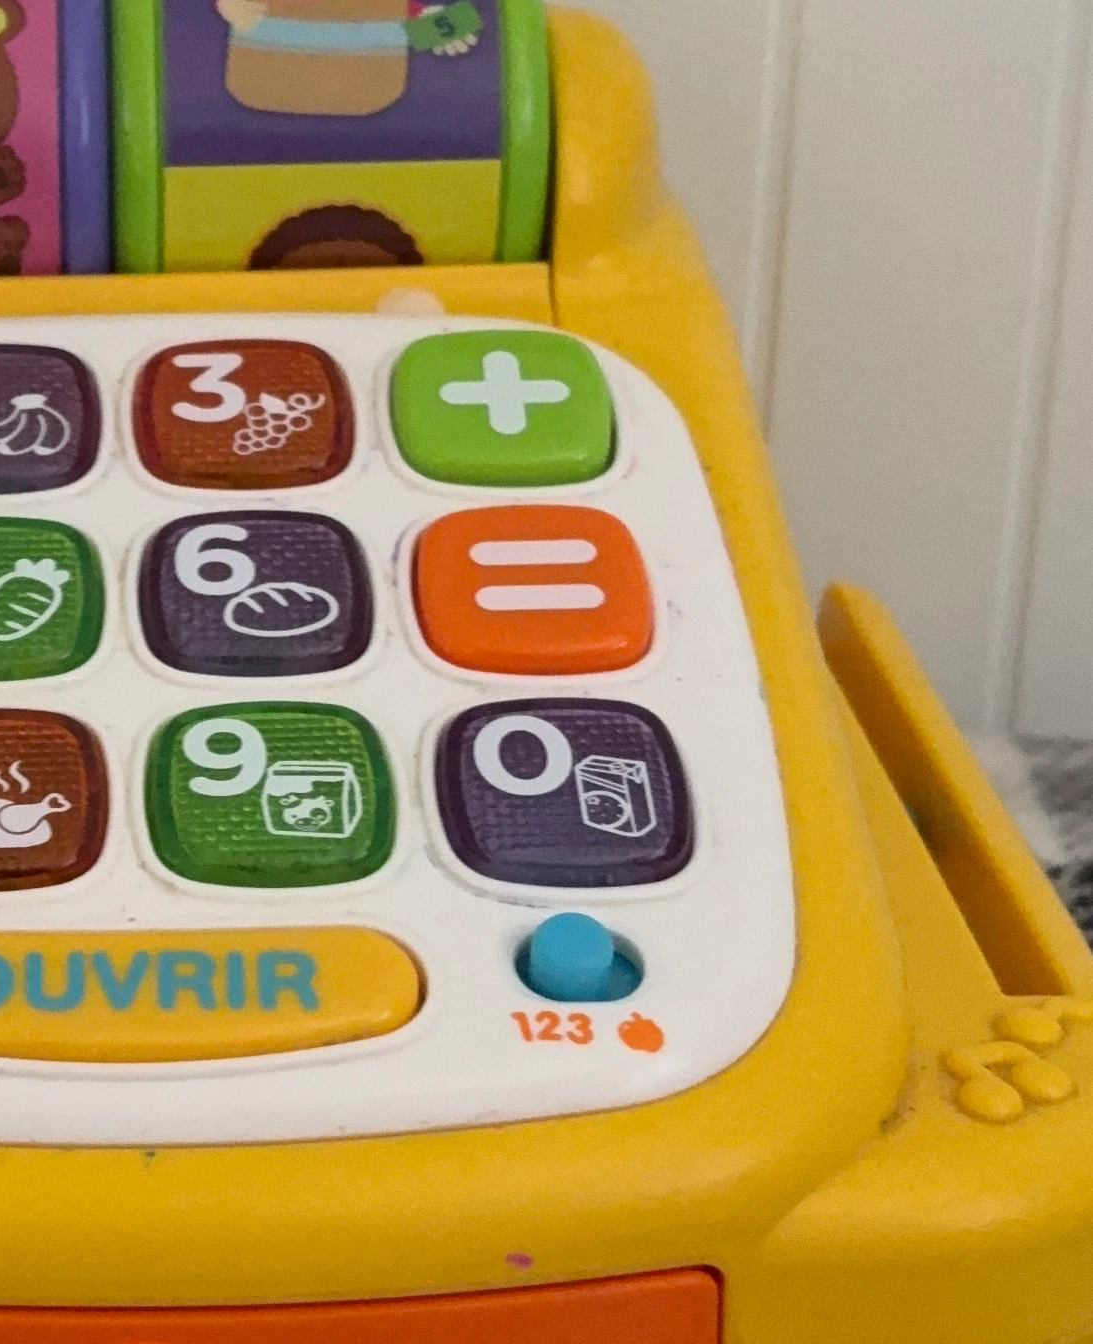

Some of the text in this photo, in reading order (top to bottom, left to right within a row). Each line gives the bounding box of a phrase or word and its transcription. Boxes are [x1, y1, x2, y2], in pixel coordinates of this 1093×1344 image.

[172, 353, 246, 422] 3
[174, 523, 255, 596] 6
[182, 718, 268, 797] 9
[473, 714, 573, 796] 0
[510, 1011, 594, 1045] 123
